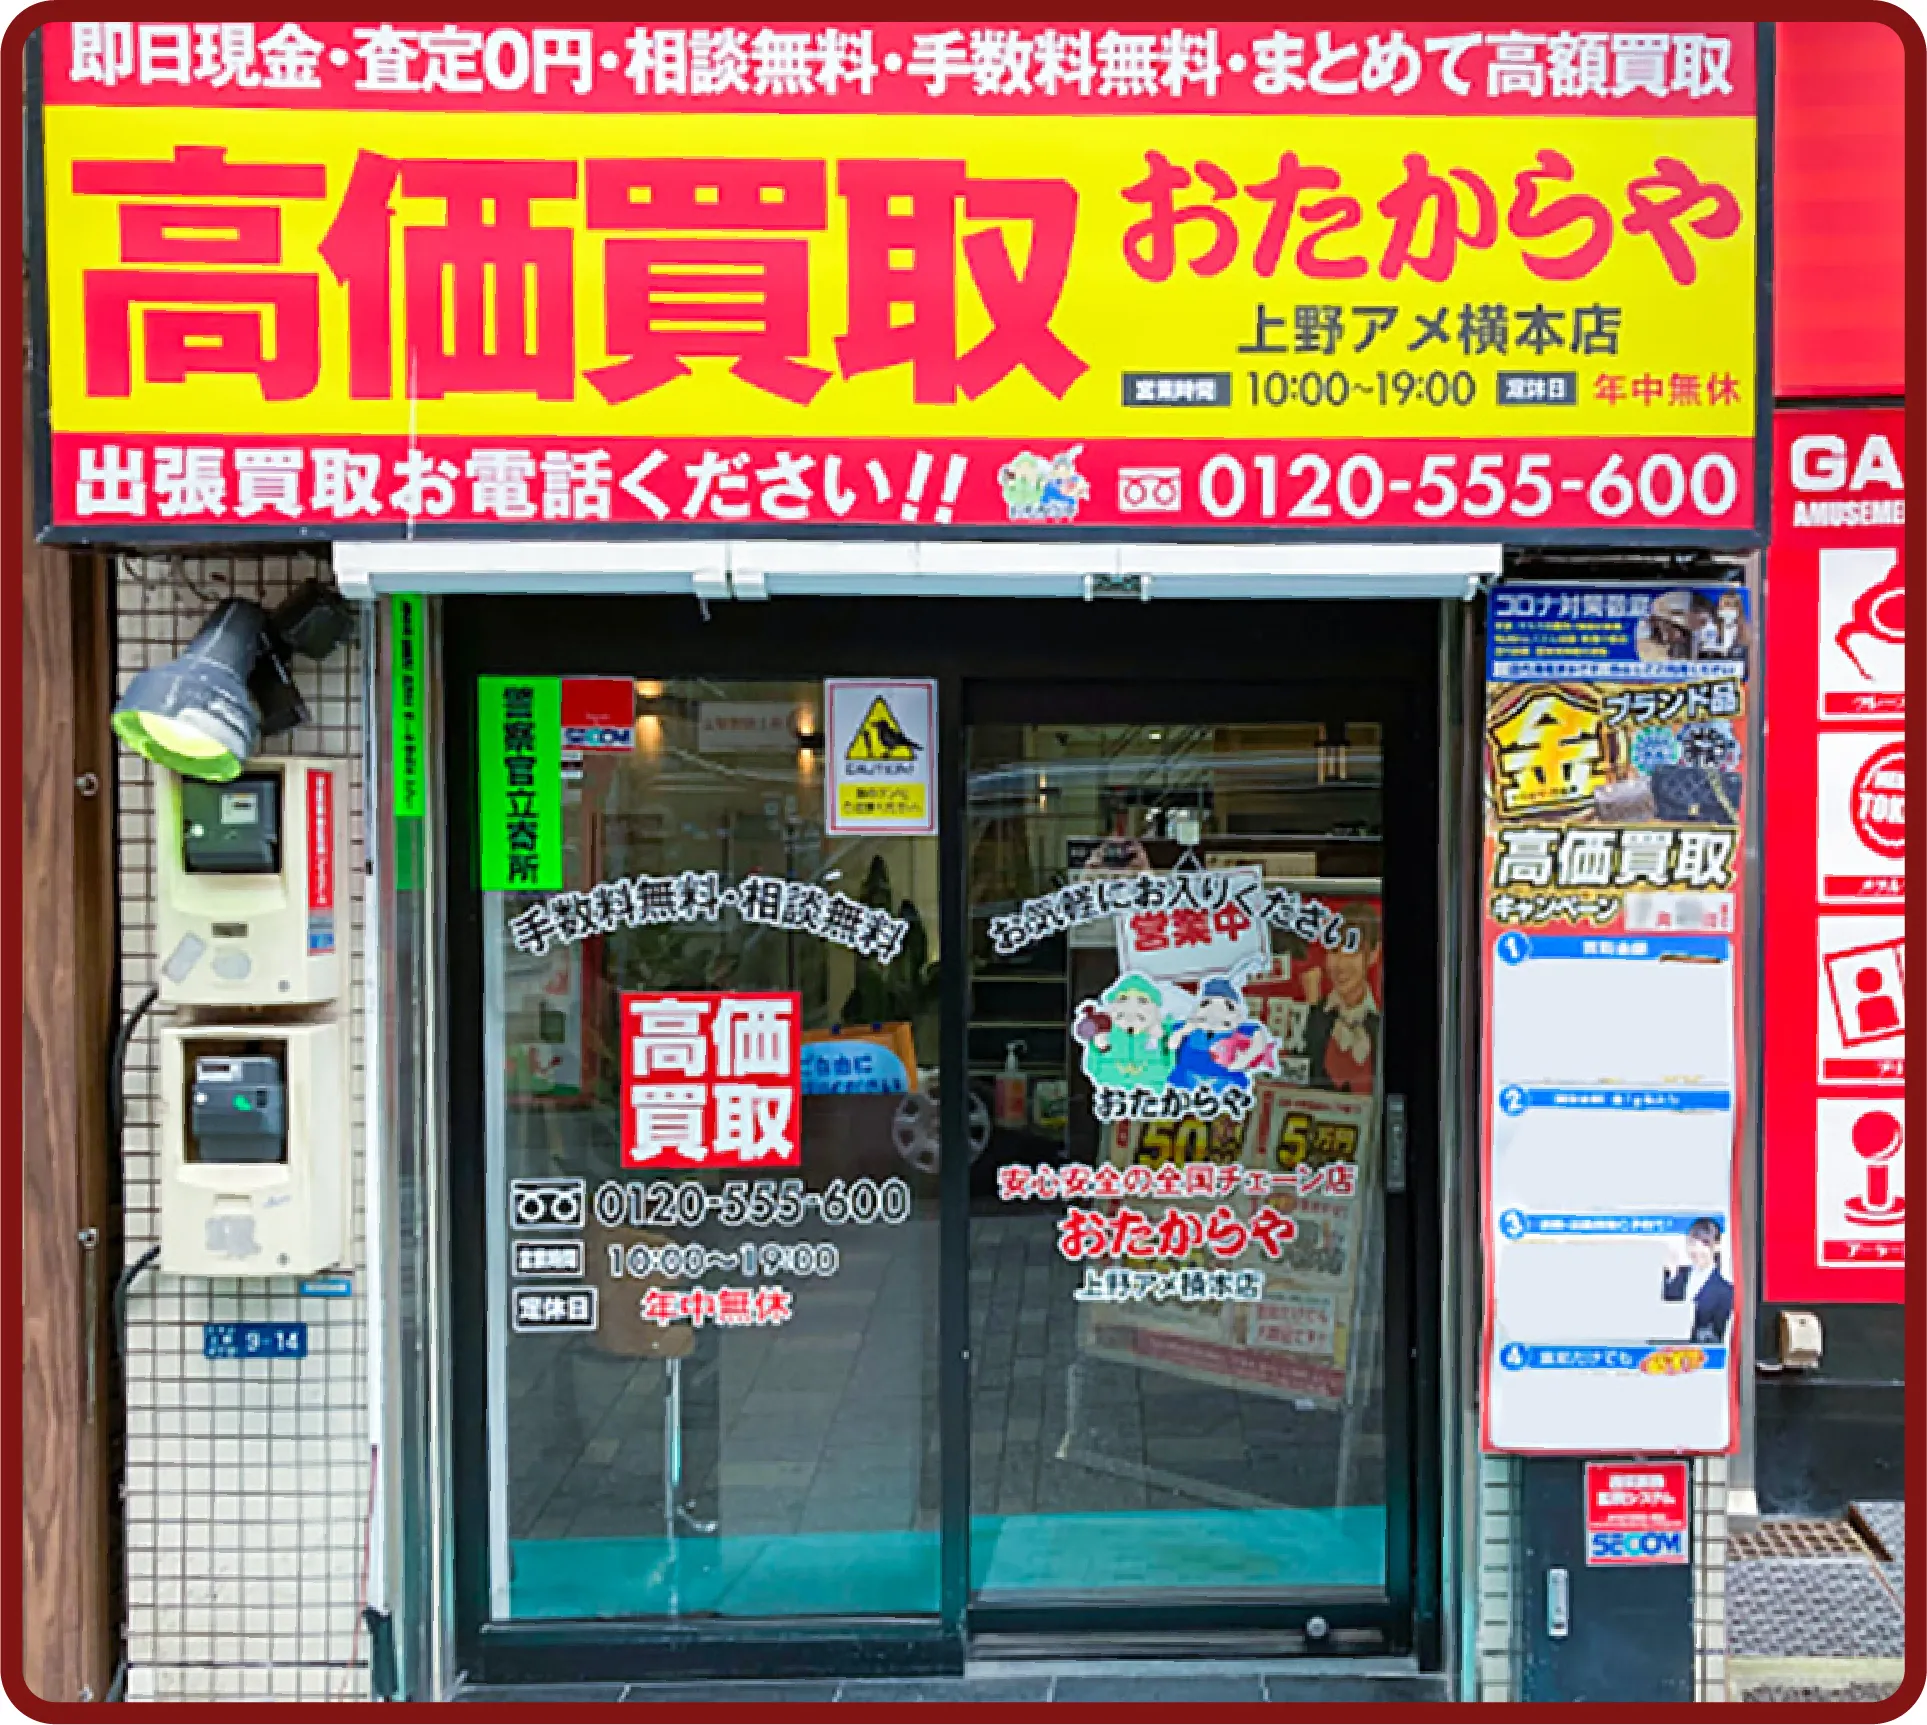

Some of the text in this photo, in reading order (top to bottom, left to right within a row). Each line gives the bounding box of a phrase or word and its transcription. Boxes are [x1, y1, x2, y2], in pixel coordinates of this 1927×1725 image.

[1120, 149, 1743, 286] おたからや
[70, 145, 1090, 406] 高価買取
[1236, 302, 1624, 357] 上野アメ横本店
[1592, 371, 1743, 408] 年中無休
[1200, 453, 1739, 519] 0120-555-600
[1790, 434, 1905, 491] GA
[1605, 682, 1739, 728] ブランド品
[1493, 695, 1609, 808] 金
[502, 686, 541, 885] 警察官立寄所
[1498, 828, 1734, 888] 高価買取
[507, 869, 910, 965] 手数料無料・相談無料
[986, 870, 1362, 956] お気軽にお入りください
[1128, 901, 1252, 953] 営業中
[1493, 892, 1622, 922] キャンペーン
[629, 997, 794, 1078] 高価
[629, 1082, 794, 1162] 買取
[1092, 1083, 1256, 1123] おたからや
[595, 1177, 911, 1228] 0120-555-600
[996, 1162, 1358, 1201] 安心安全の全国チェーン店
[1058, 1204, 1299, 1260] おたからや
[640, 1285, 796, 1328] 年中無休
[1073, 1266, 1266, 1303] 上野アメ横本店
[1591, 1531, 1681, 1556] SECOM
